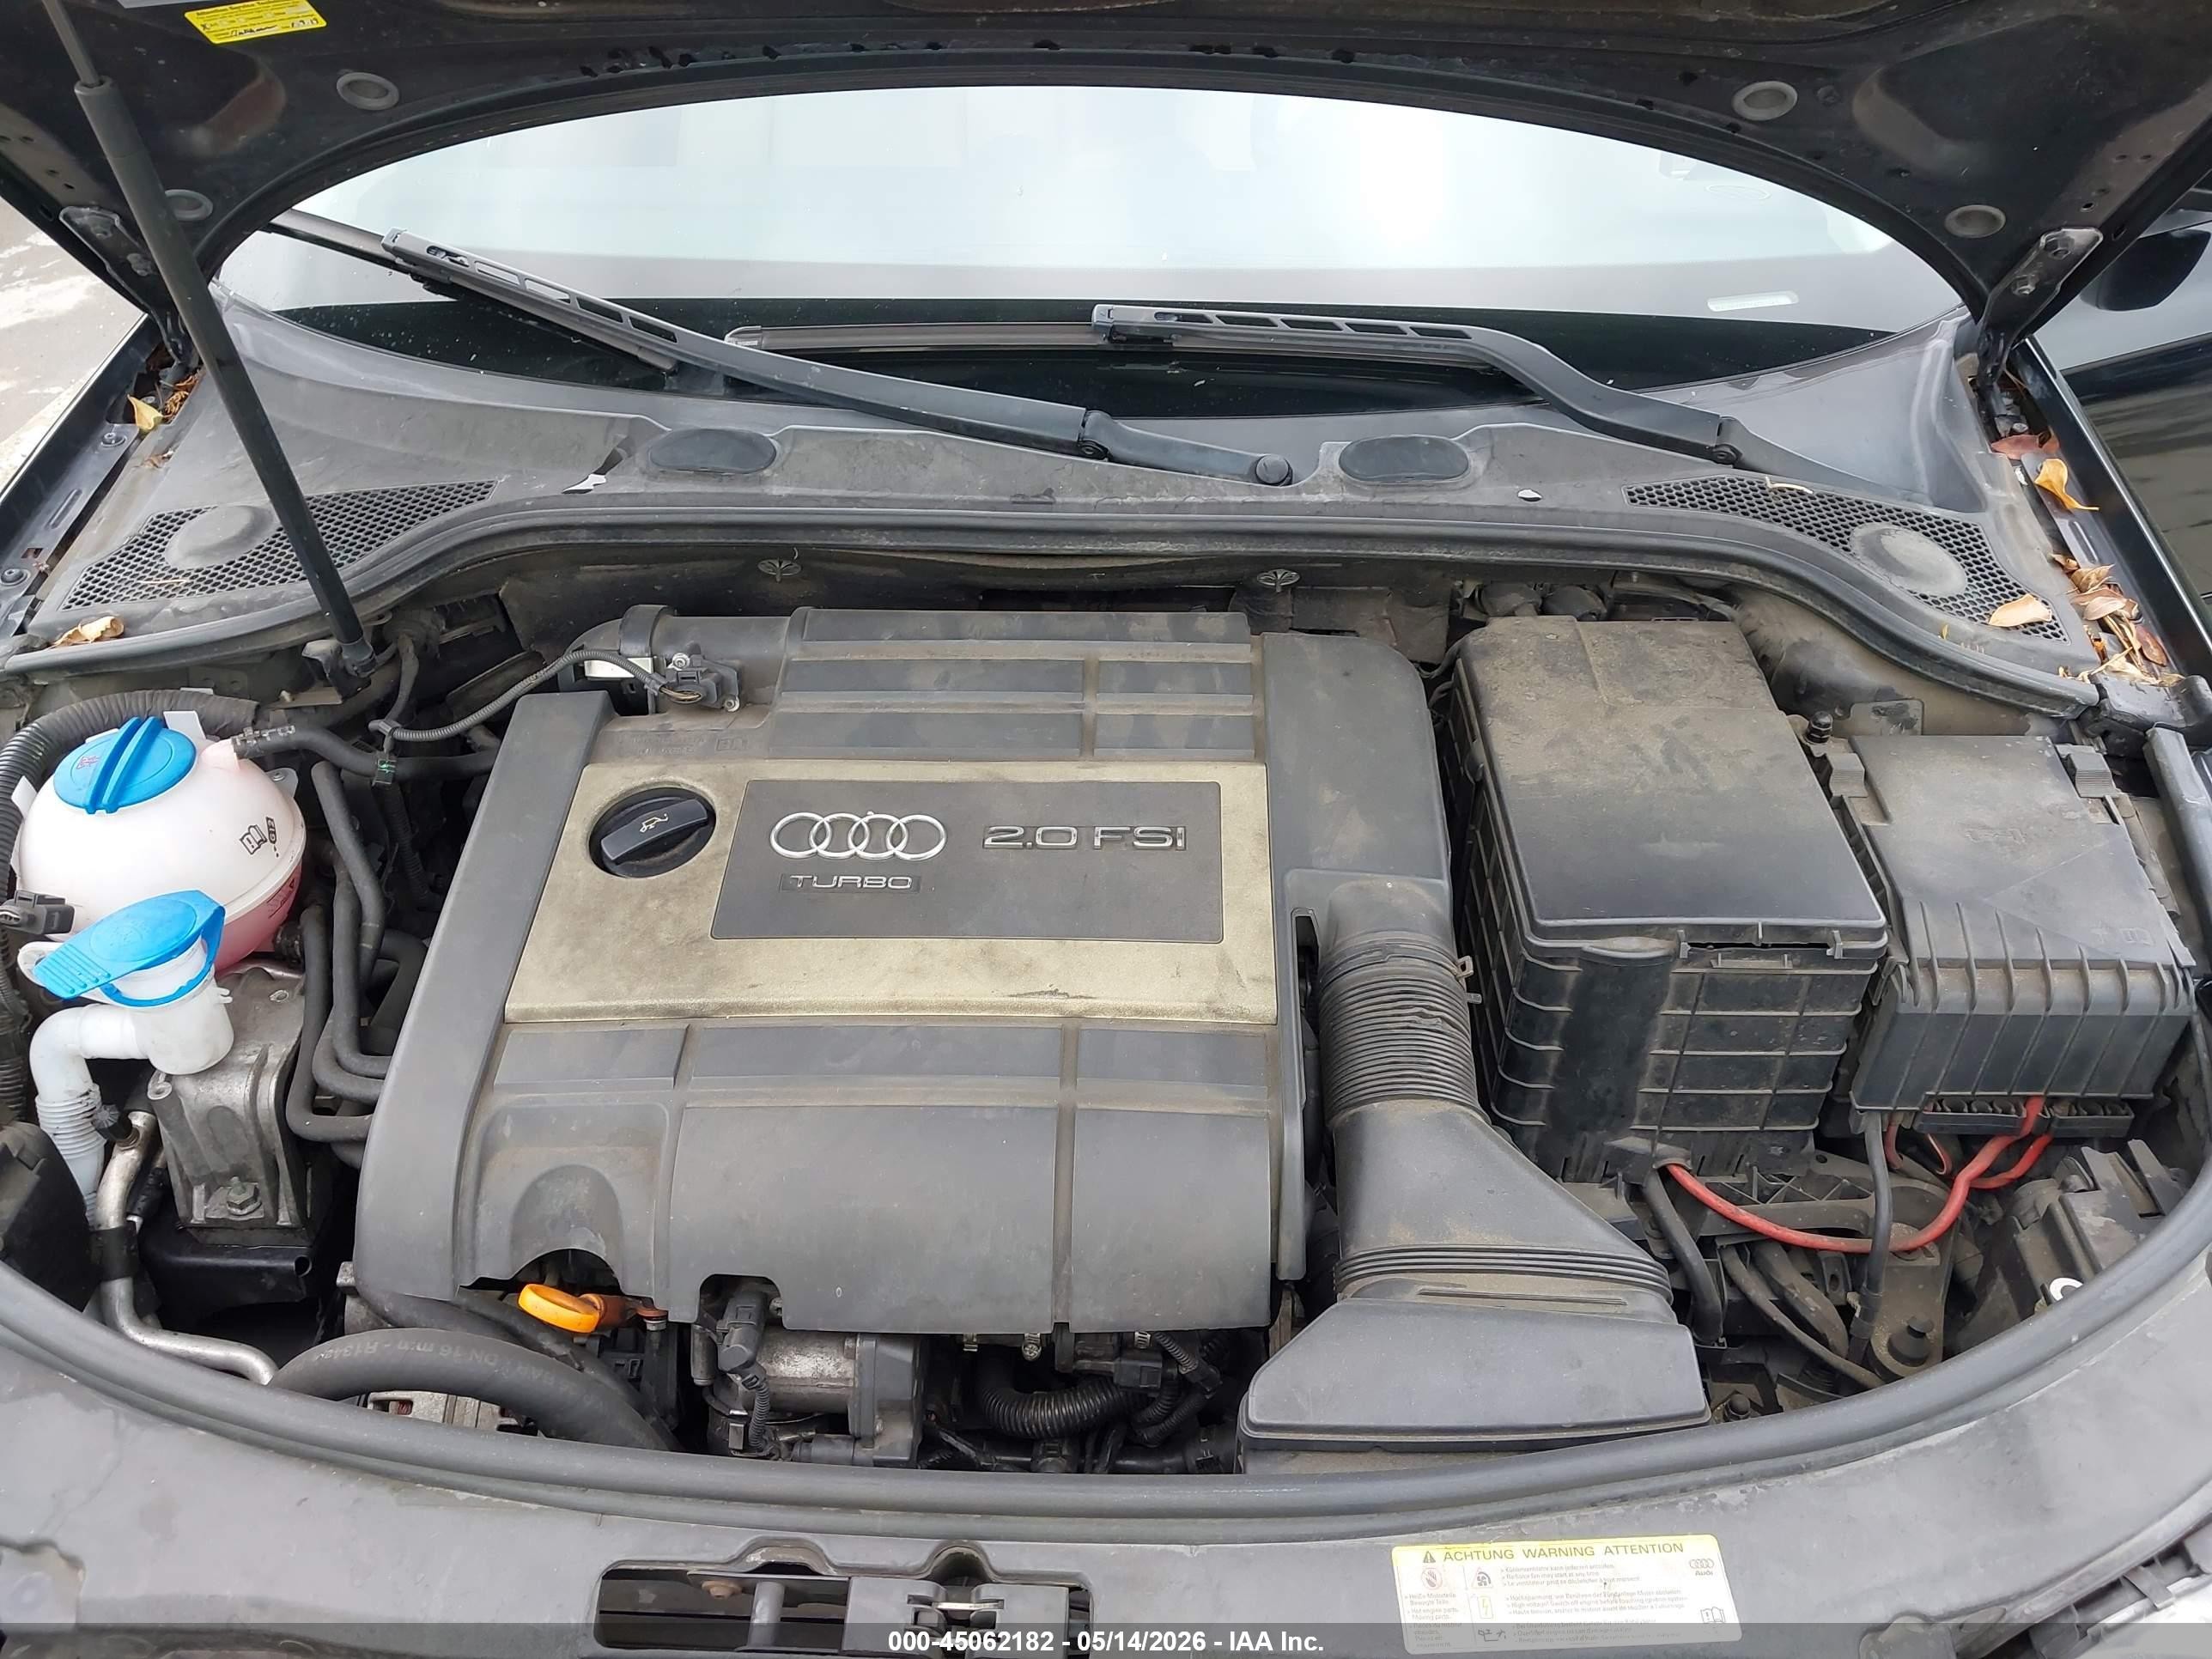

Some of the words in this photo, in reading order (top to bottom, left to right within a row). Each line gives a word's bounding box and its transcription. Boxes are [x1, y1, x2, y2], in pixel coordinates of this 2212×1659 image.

[267, 820, 276, 842] G12
[984, 826, 1079, 849] 2.0
[1092, 826, 1188, 849] FSI
[790, 876, 913, 890] TURBO
[1443, 1549, 1515, 1562] ACHTUNG
[1522, 1546, 1595, 1559] WARNING
[1604, 1542, 1685, 1555] ATTENTION
